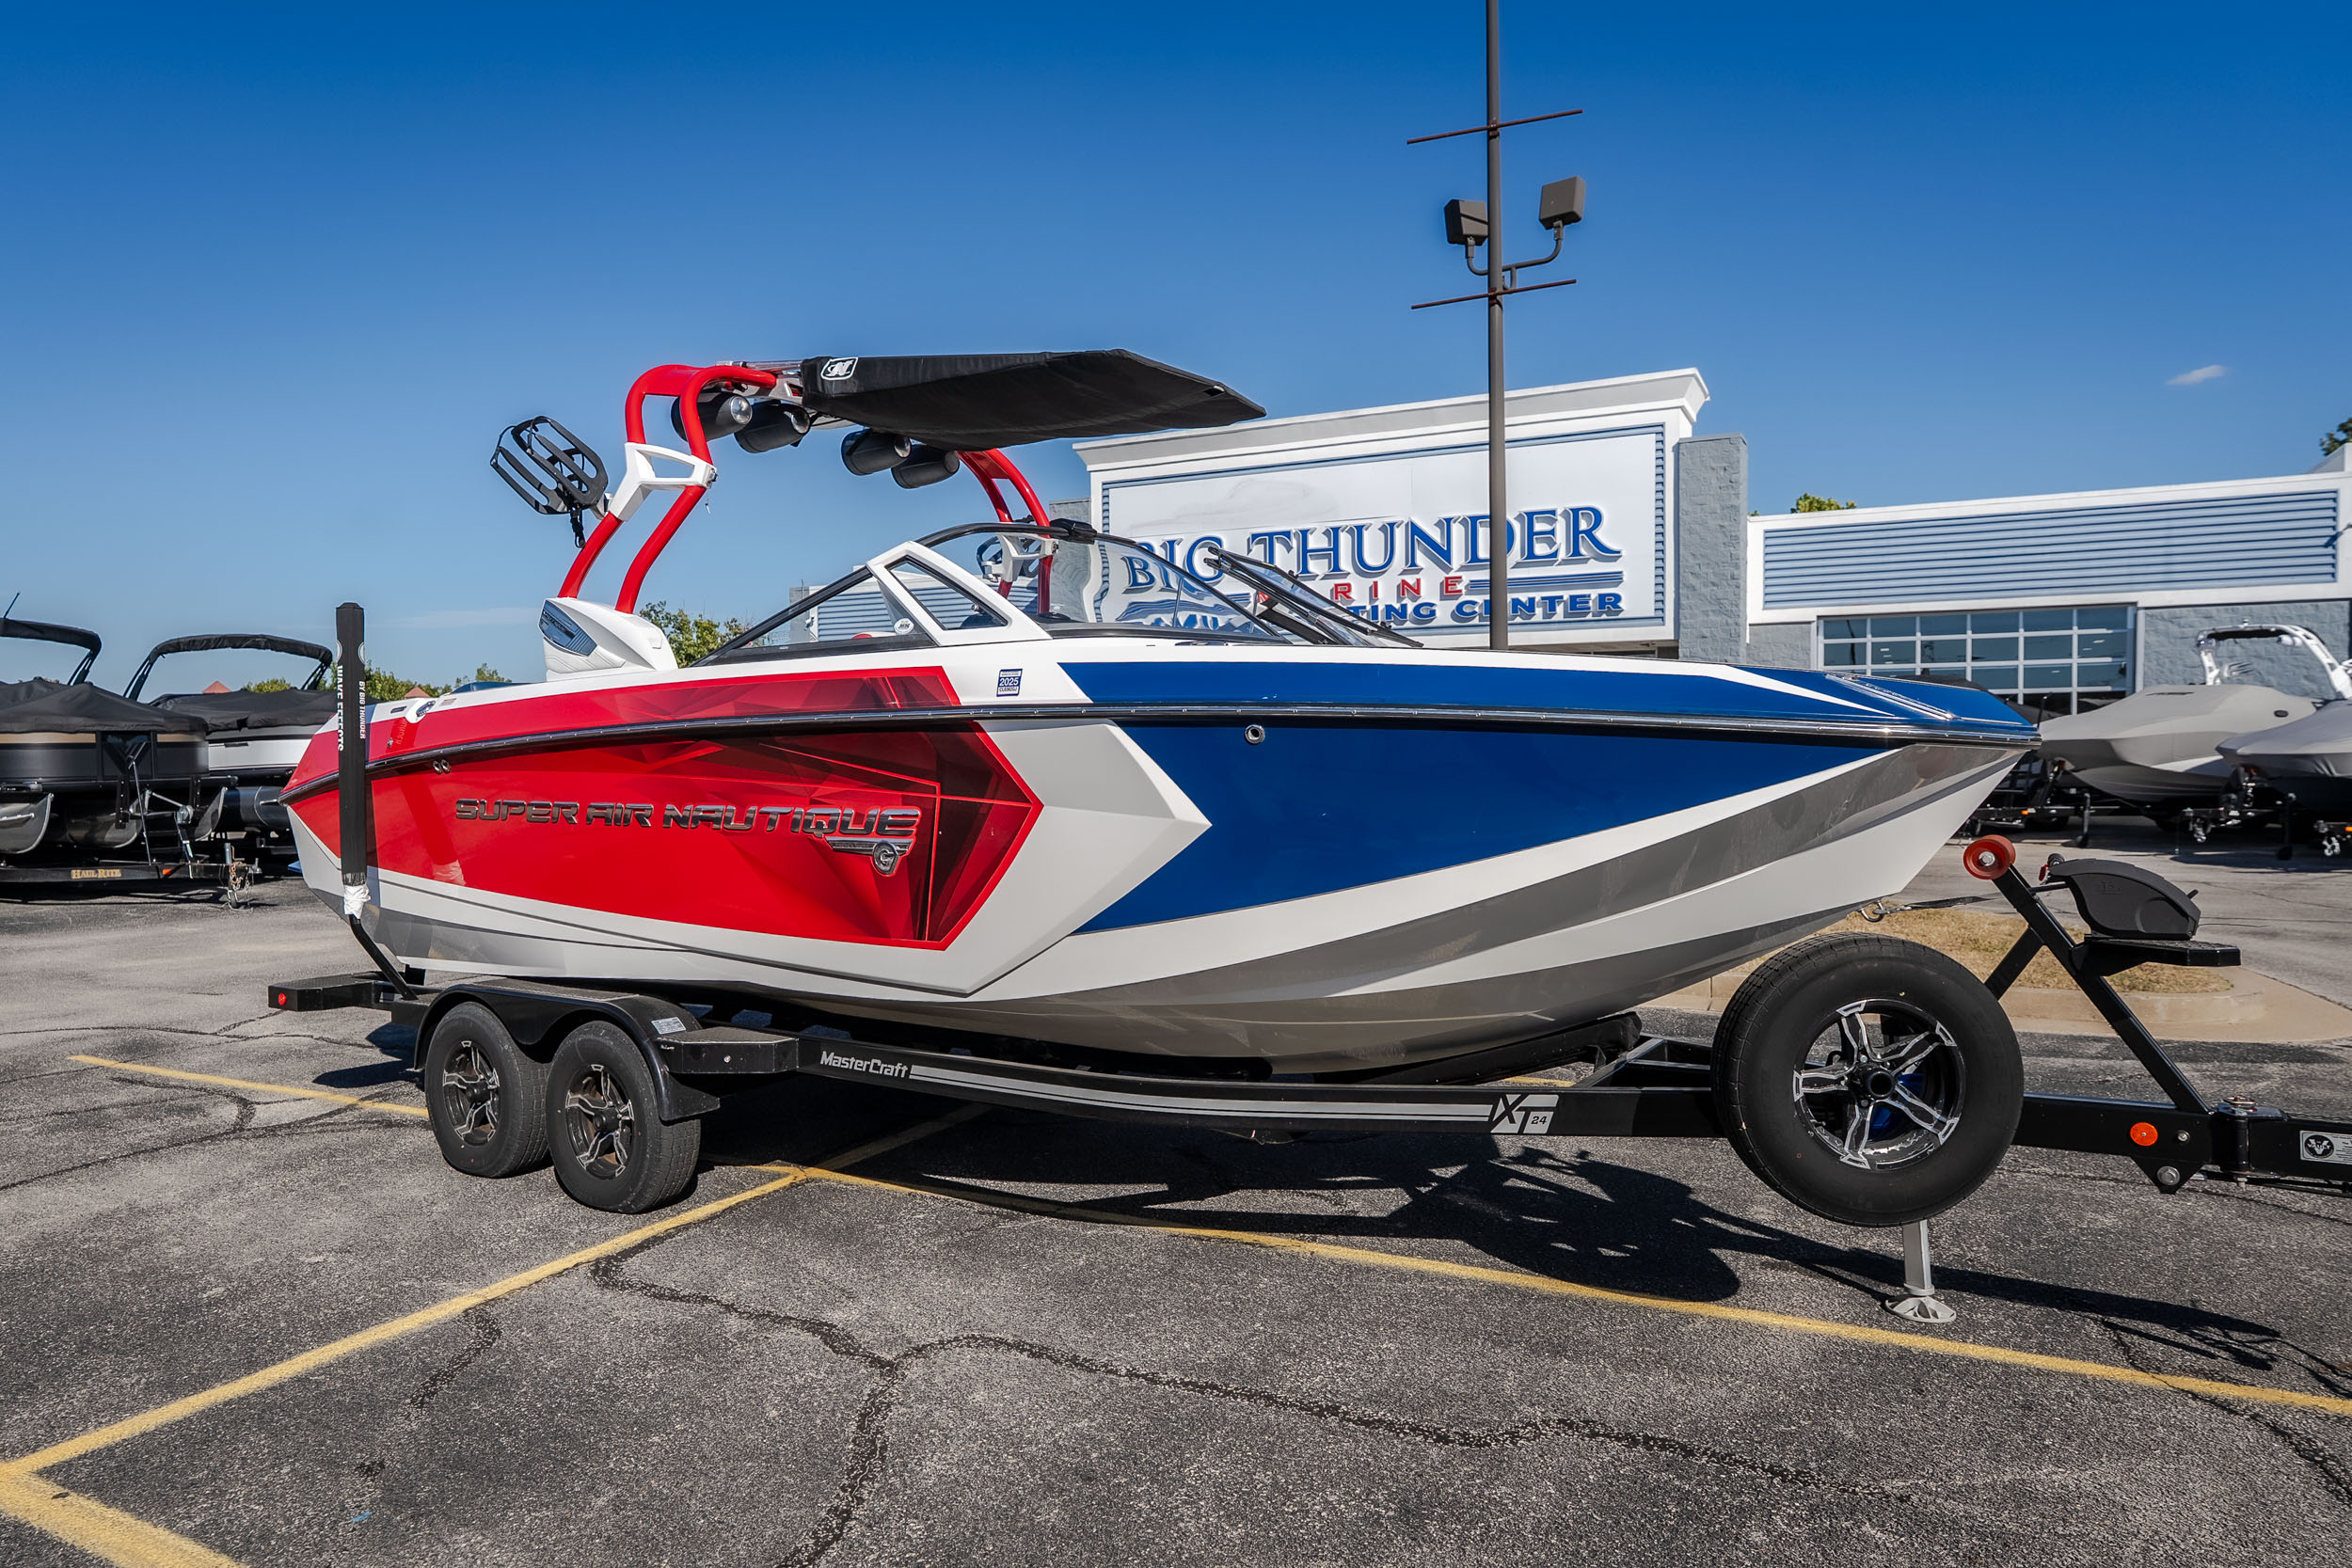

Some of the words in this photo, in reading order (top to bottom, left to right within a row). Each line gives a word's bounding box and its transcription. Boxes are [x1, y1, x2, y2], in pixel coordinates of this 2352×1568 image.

[1124, 534, 1225, 590] BIG
[1248, 505, 1623, 580] THUNDER
[1346, 601, 1438, 625] TING
[1454, 592, 1624, 621] CNTER
[358, 681, 365, 691] BY
[999, 677, 1019, 687] 2025
[455, 799, 580, 825] SUPER
[586, 802, 654, 828] AIR
[662, 803, 922, 838] NAUTIQUE
[819, 1050, 909, 1079] MasterCraft
[1531, 1116, 1548, 1125] 24
